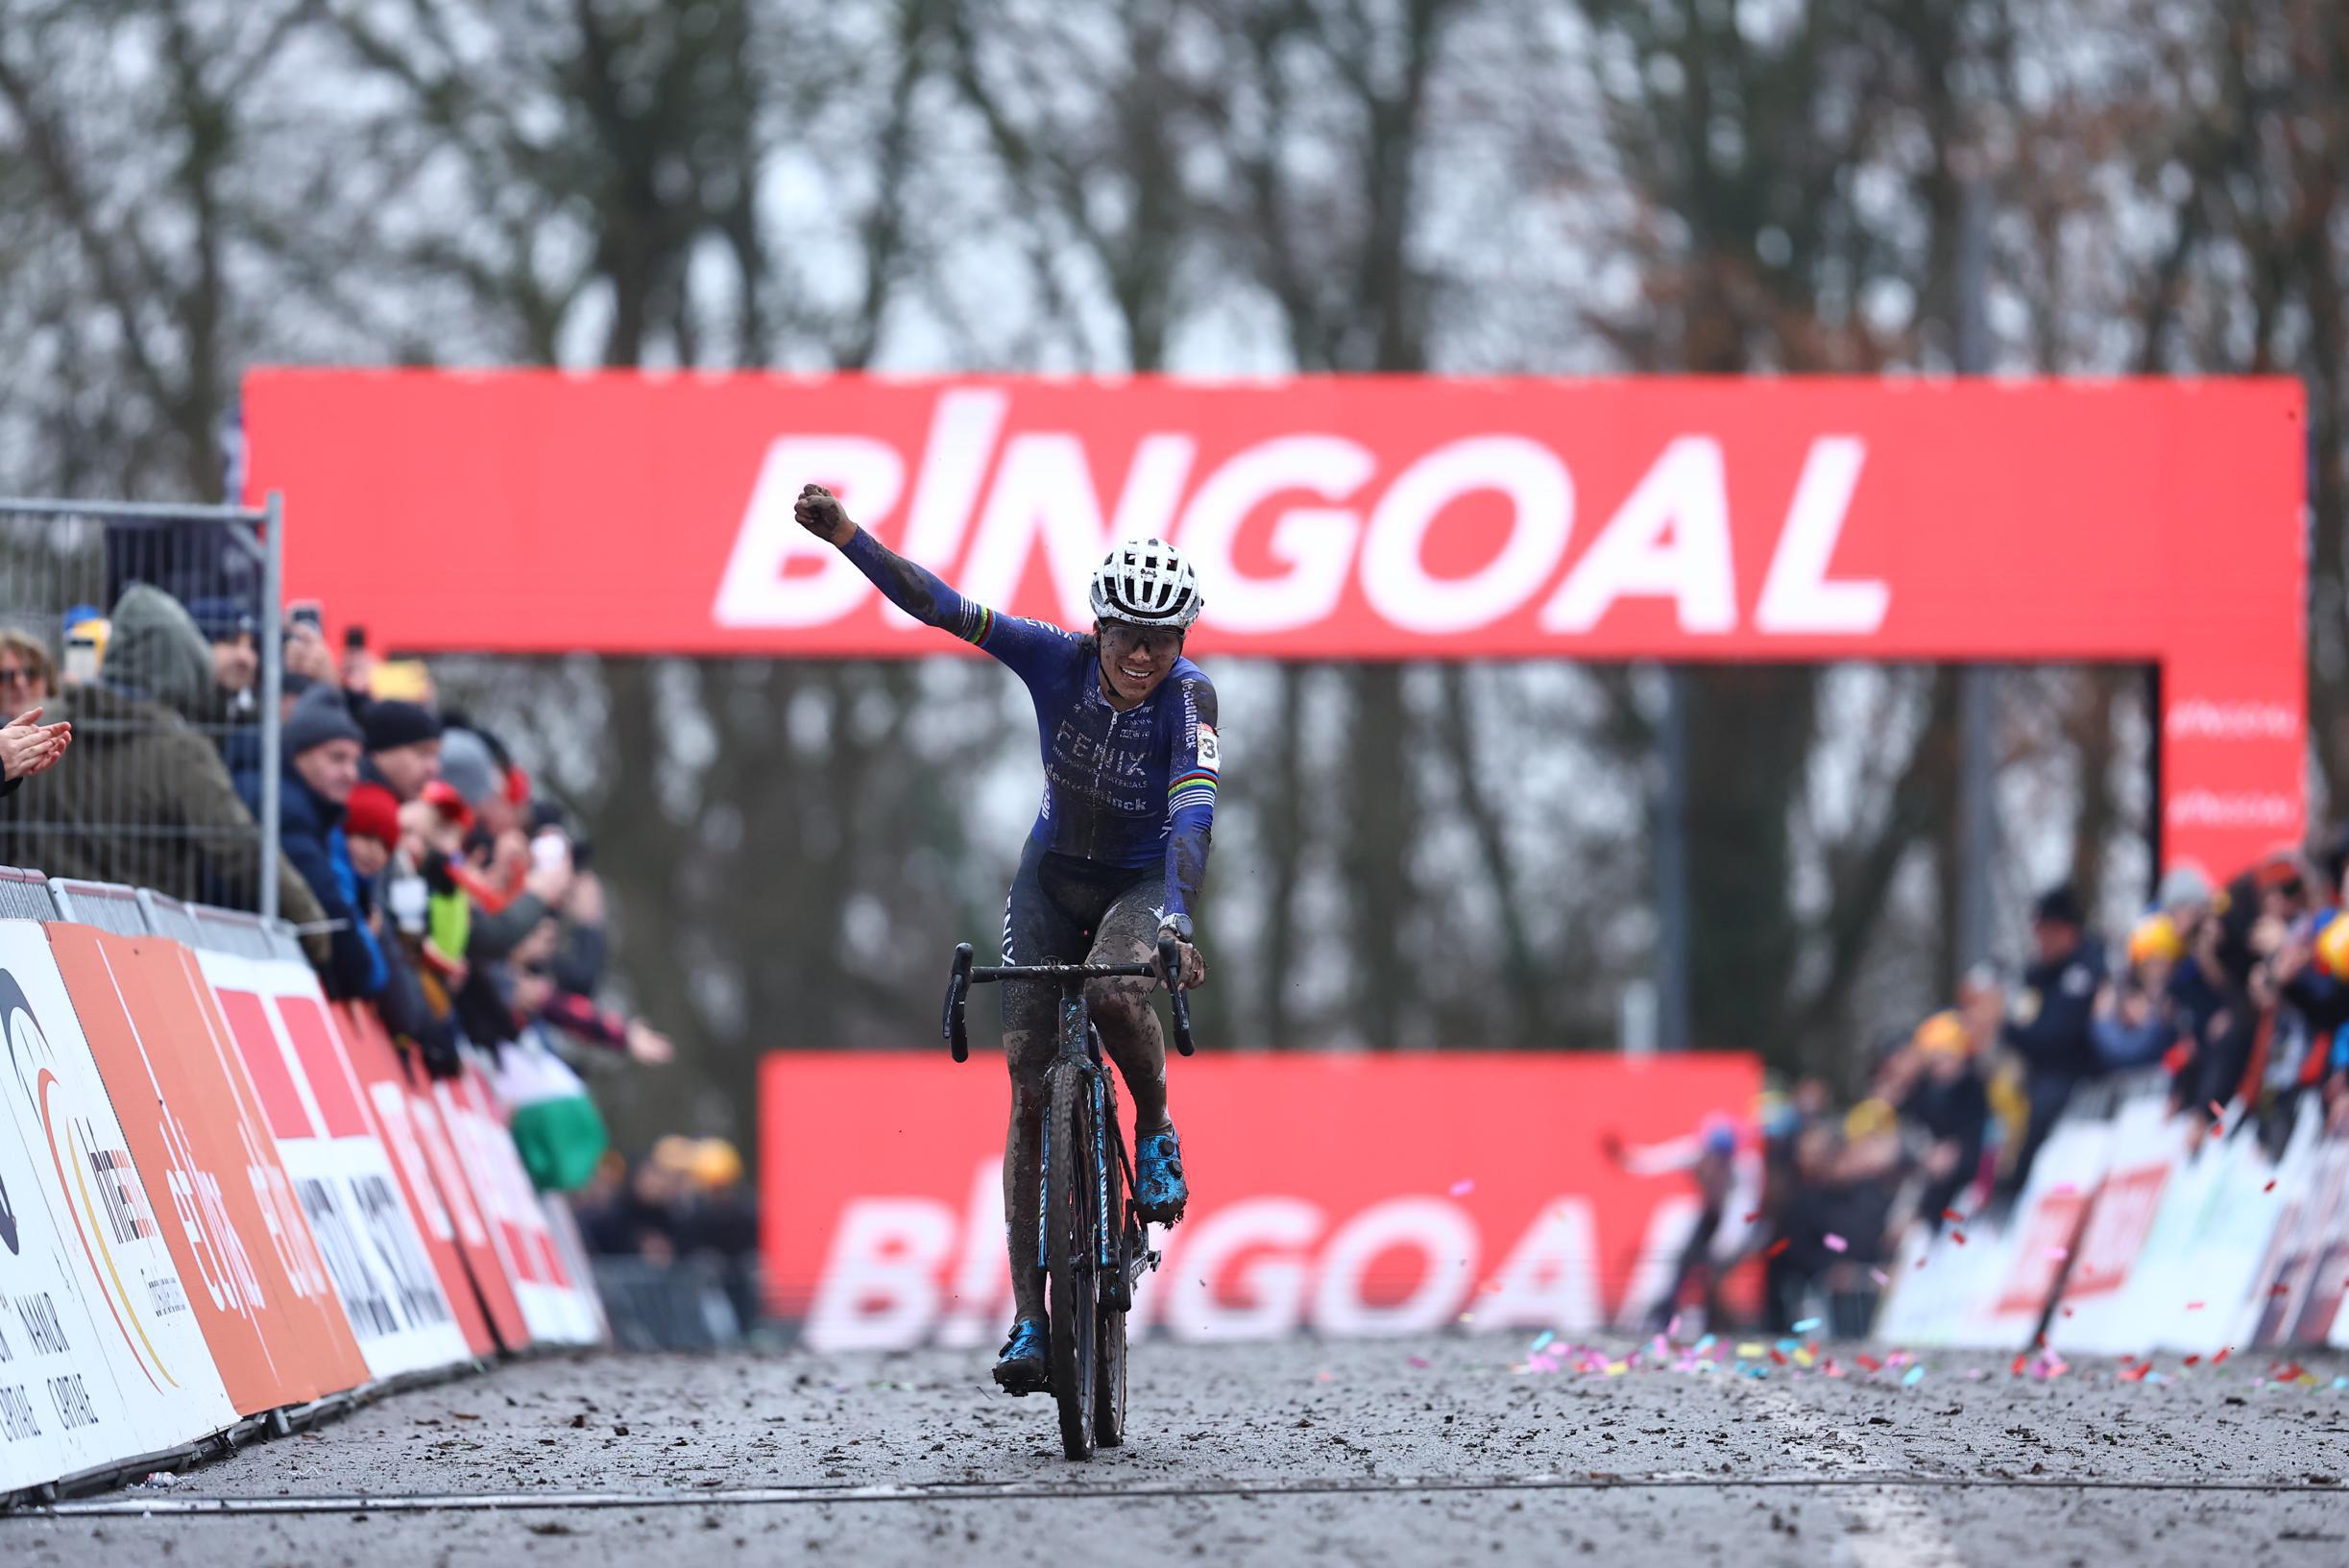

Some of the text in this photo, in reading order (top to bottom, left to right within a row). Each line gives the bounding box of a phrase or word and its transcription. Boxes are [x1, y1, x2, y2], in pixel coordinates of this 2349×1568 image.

[713, 389, 1891, 634] BINGOAL
[1057, 718, 1146, 776] FENIX
[1202, 737, 1216, 760] 3
[801, 1158, 1703, 1348] BIGOAL
[14, 1291, 70, 1357] NAMUR
[47, 1373, 99, 1431] CAPITALE
